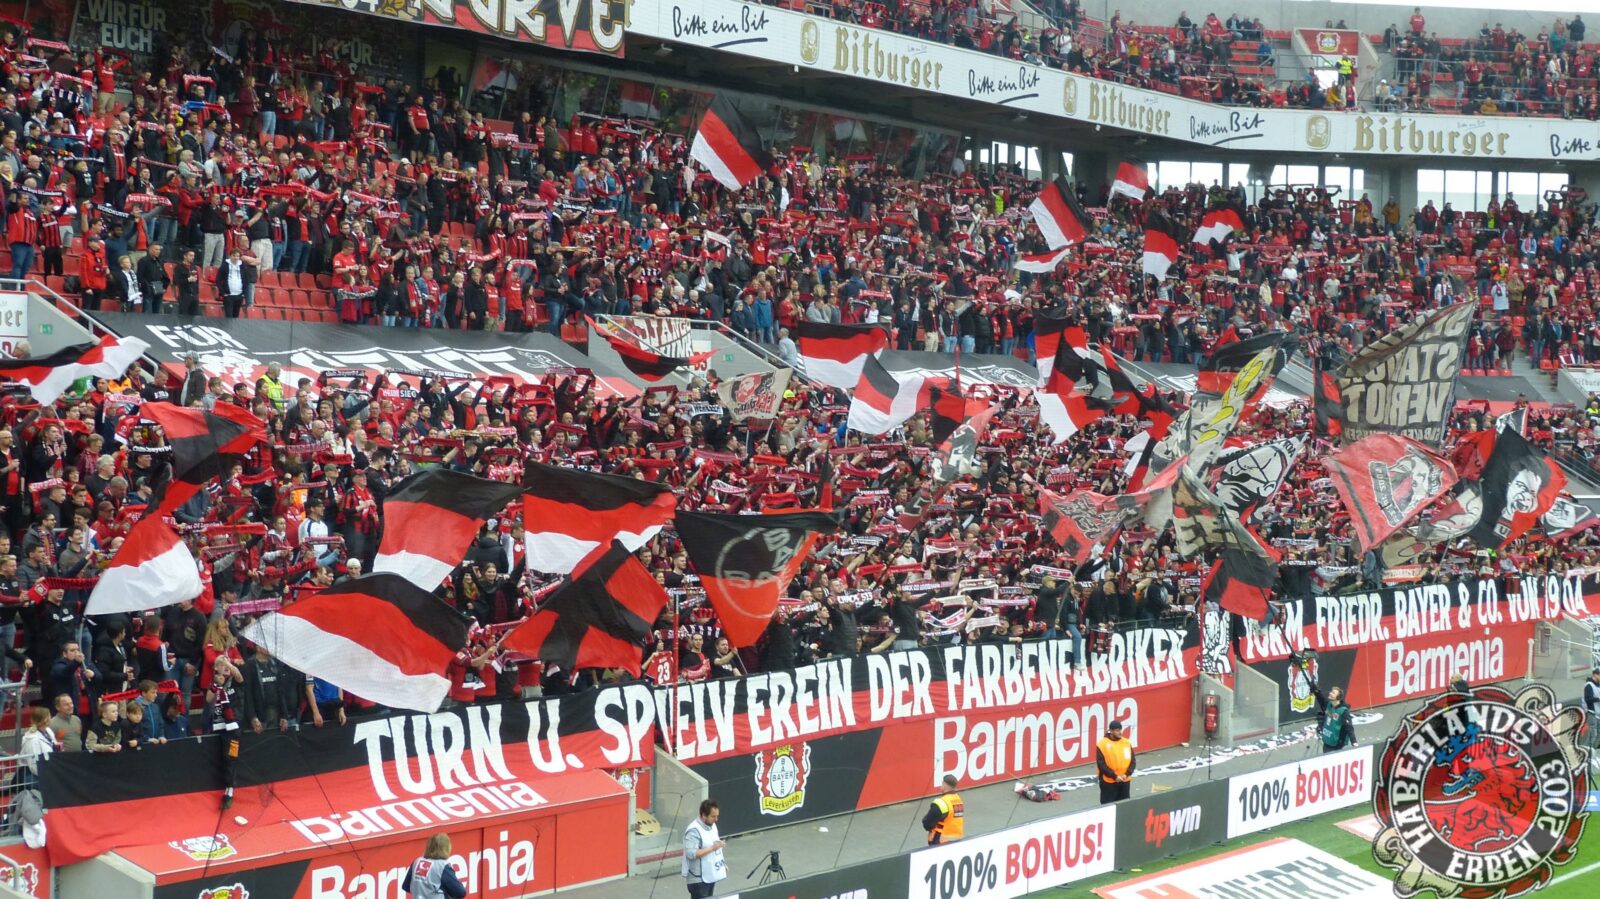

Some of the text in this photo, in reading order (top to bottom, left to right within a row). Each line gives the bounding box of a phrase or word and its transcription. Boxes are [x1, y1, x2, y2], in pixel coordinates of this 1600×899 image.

[87, 0, 126, 23] WIR
[673, 6, 769, 38] Bitte ein Bit
[101, 23, 153, 53] EUCH
[833, 26, 944, 90] Bitburger
[968, 66, 1040, 97] Bitte ein Bit
[1088, 81, 1171, 135] Bitburger
[1190, 111, 1265, 139] Bitte ein Bit
[1352, 116, 1510, 156] Bitburger
[1550, 134, 1591, 157] Bitte
[0, 309, 23, 328] er
[145, 324, 249, 350] FÜR
[1315, 592, 1390, 648] FRIEDR.
[1394, 584, 1452, 638] BAYER
[1457, 582, 1472, 629] &
[1477, 579, 1503, 625] CO.
[658, 662, 670, 684] 23
[1384, 627, 1504, 698] Barmenia
[353, 704, 518, 801] TURN
[525, 698, 584, 773] U.
[866, 651, 935, 722] DER
[944, 628, 1188, 711] FARBENFABRIKEN
[933, 697, 1138, 788] Barmenia
[765, 795, 800, 808] Leverkusen
[1238, 759, 1364, 822] 100% BONUS!
[290, 782, 548, 843] Barmenia
[1144, 805, 1202, 848] tipwin
[311, 831, 535, 899] Barenia
[924, 823, 1103, 899] 100% BONUS!
